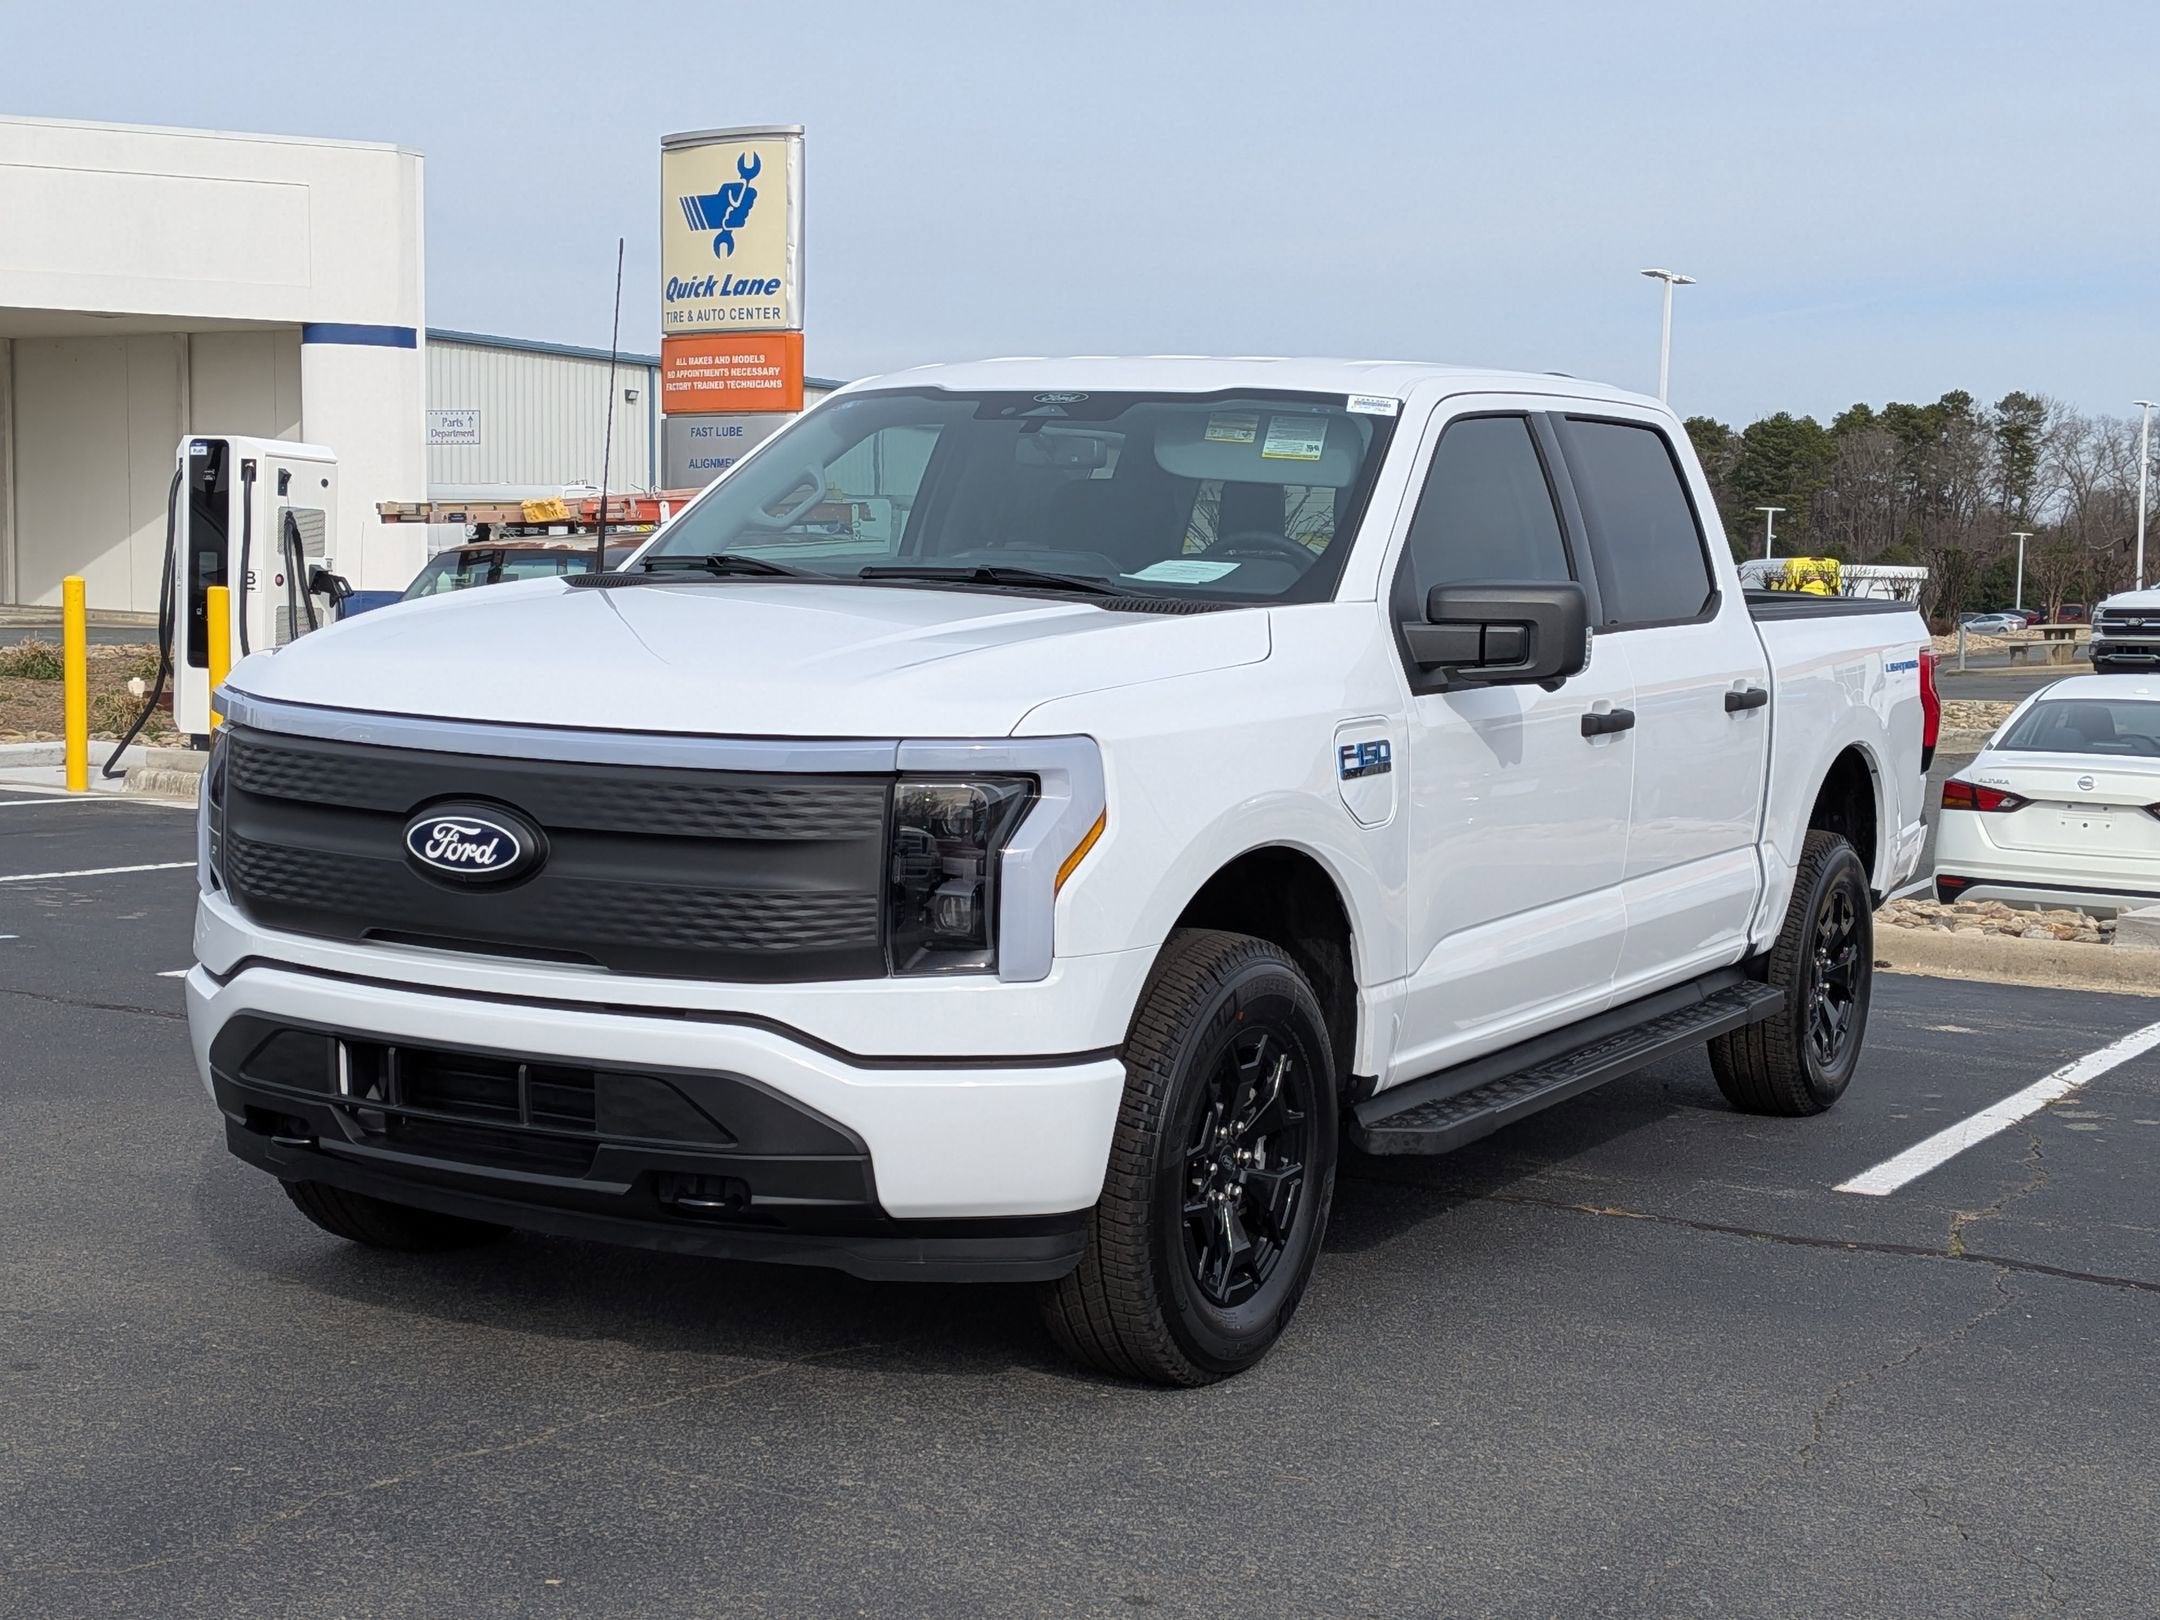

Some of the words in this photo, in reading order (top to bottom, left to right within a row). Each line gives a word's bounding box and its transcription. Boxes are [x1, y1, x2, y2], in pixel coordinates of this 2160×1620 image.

[665, 274, 719, 303] Quick
[719, 273, 782, 297] Lane
[666, 311, 684, 325] TIRE
[687, 310, 694, 322] &
[696, 308, 725, 322] AUTO
[729, 307, 781, 321] CENTER
[675, 357, 688, 366] ALL
[688, 355, 713, 366] MAKES
[714, 355, 731, 365] AND
[731, 354, 766, 364] MODELS
[667, 370, 676, 379] NO
[676, 367, 730, 379] APPOINTMENTS
[730, 366, 781, 377] NECESSARY
[666, 381, 692, 392] FACTORY
[693, 380, 725, 390] TRAINED
[726, 379, 783, 389] TECHNICIANS
[441, 417, 464, 428] Parts
[430, 428, 475, 440] Department
[690, 426, 714, 437] FAST
[715, 426, 743, 437] LUBE
[688, 457, 736, 469] ALIGNME
[1339, 739, 1391, 769] F-150
[425, 822, 500, 865] Ford
